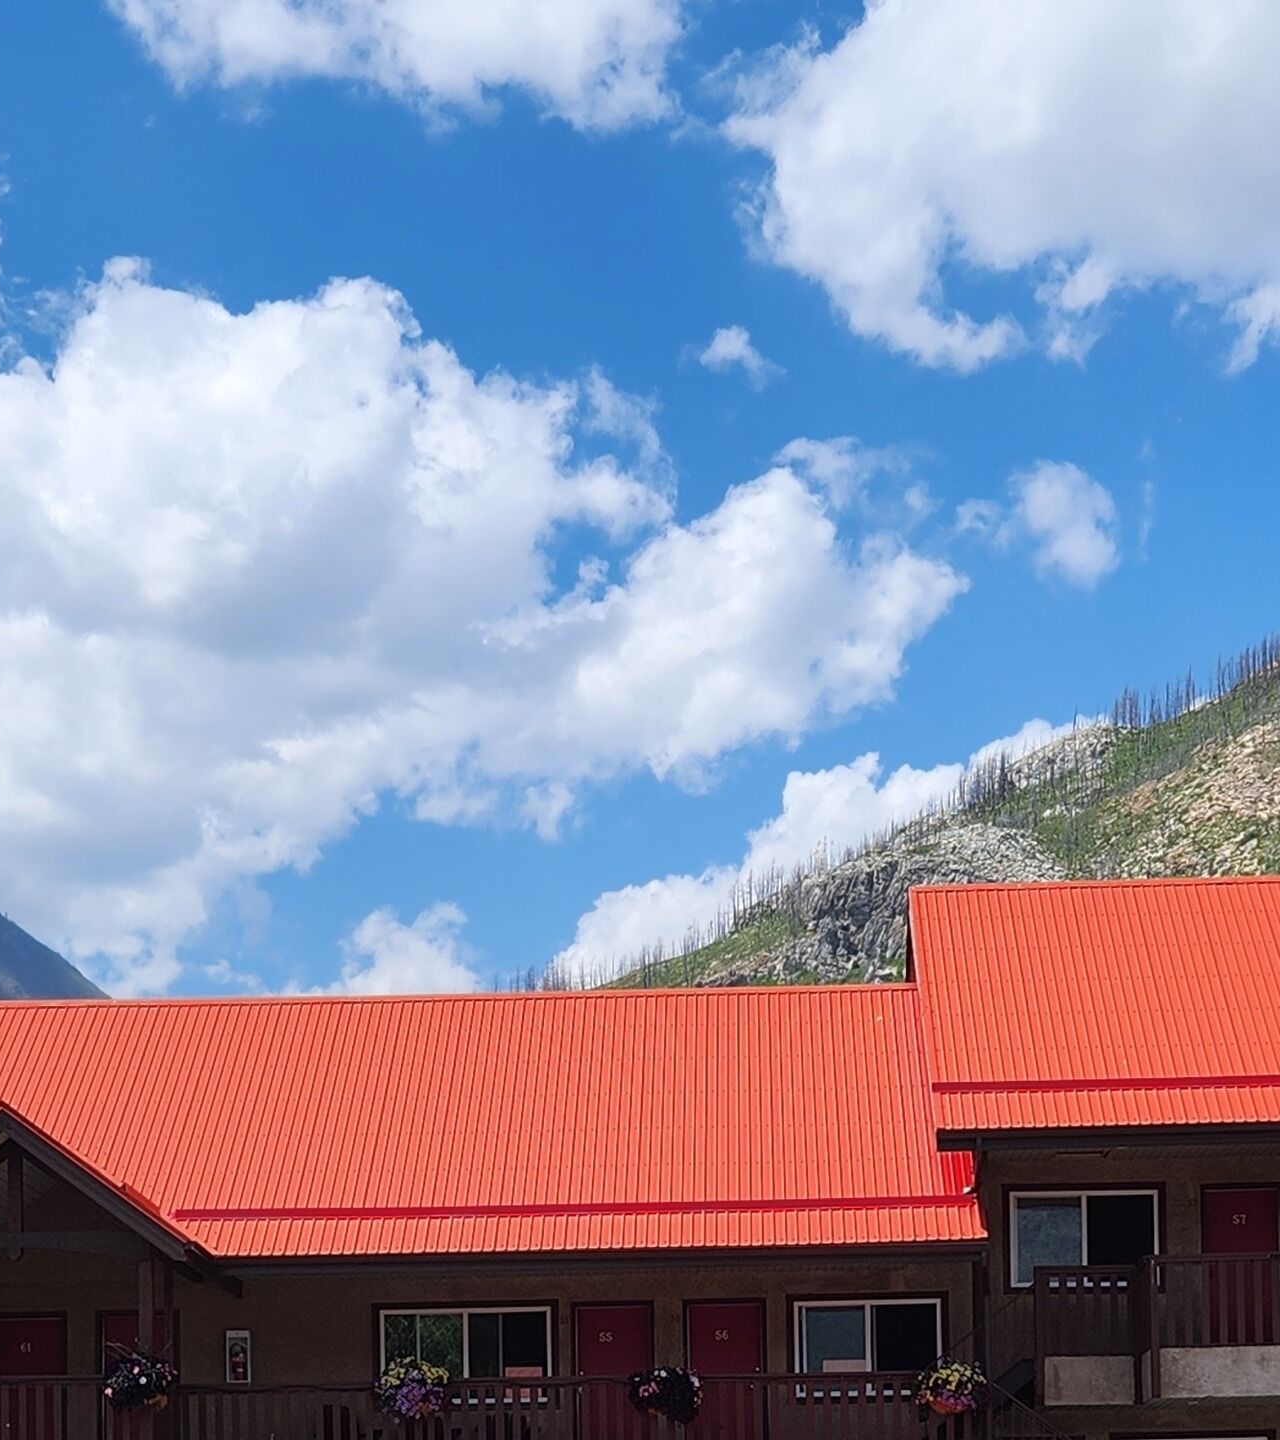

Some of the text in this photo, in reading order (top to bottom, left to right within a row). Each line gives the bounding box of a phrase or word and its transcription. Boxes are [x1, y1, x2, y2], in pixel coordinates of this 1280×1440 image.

[1231, 1213, 1247, 1225] 57
[598, 1331, 614, 1343] 55
[714, 1329, 729, 1341] 56
[19, 1341, 32, 1353] 61
